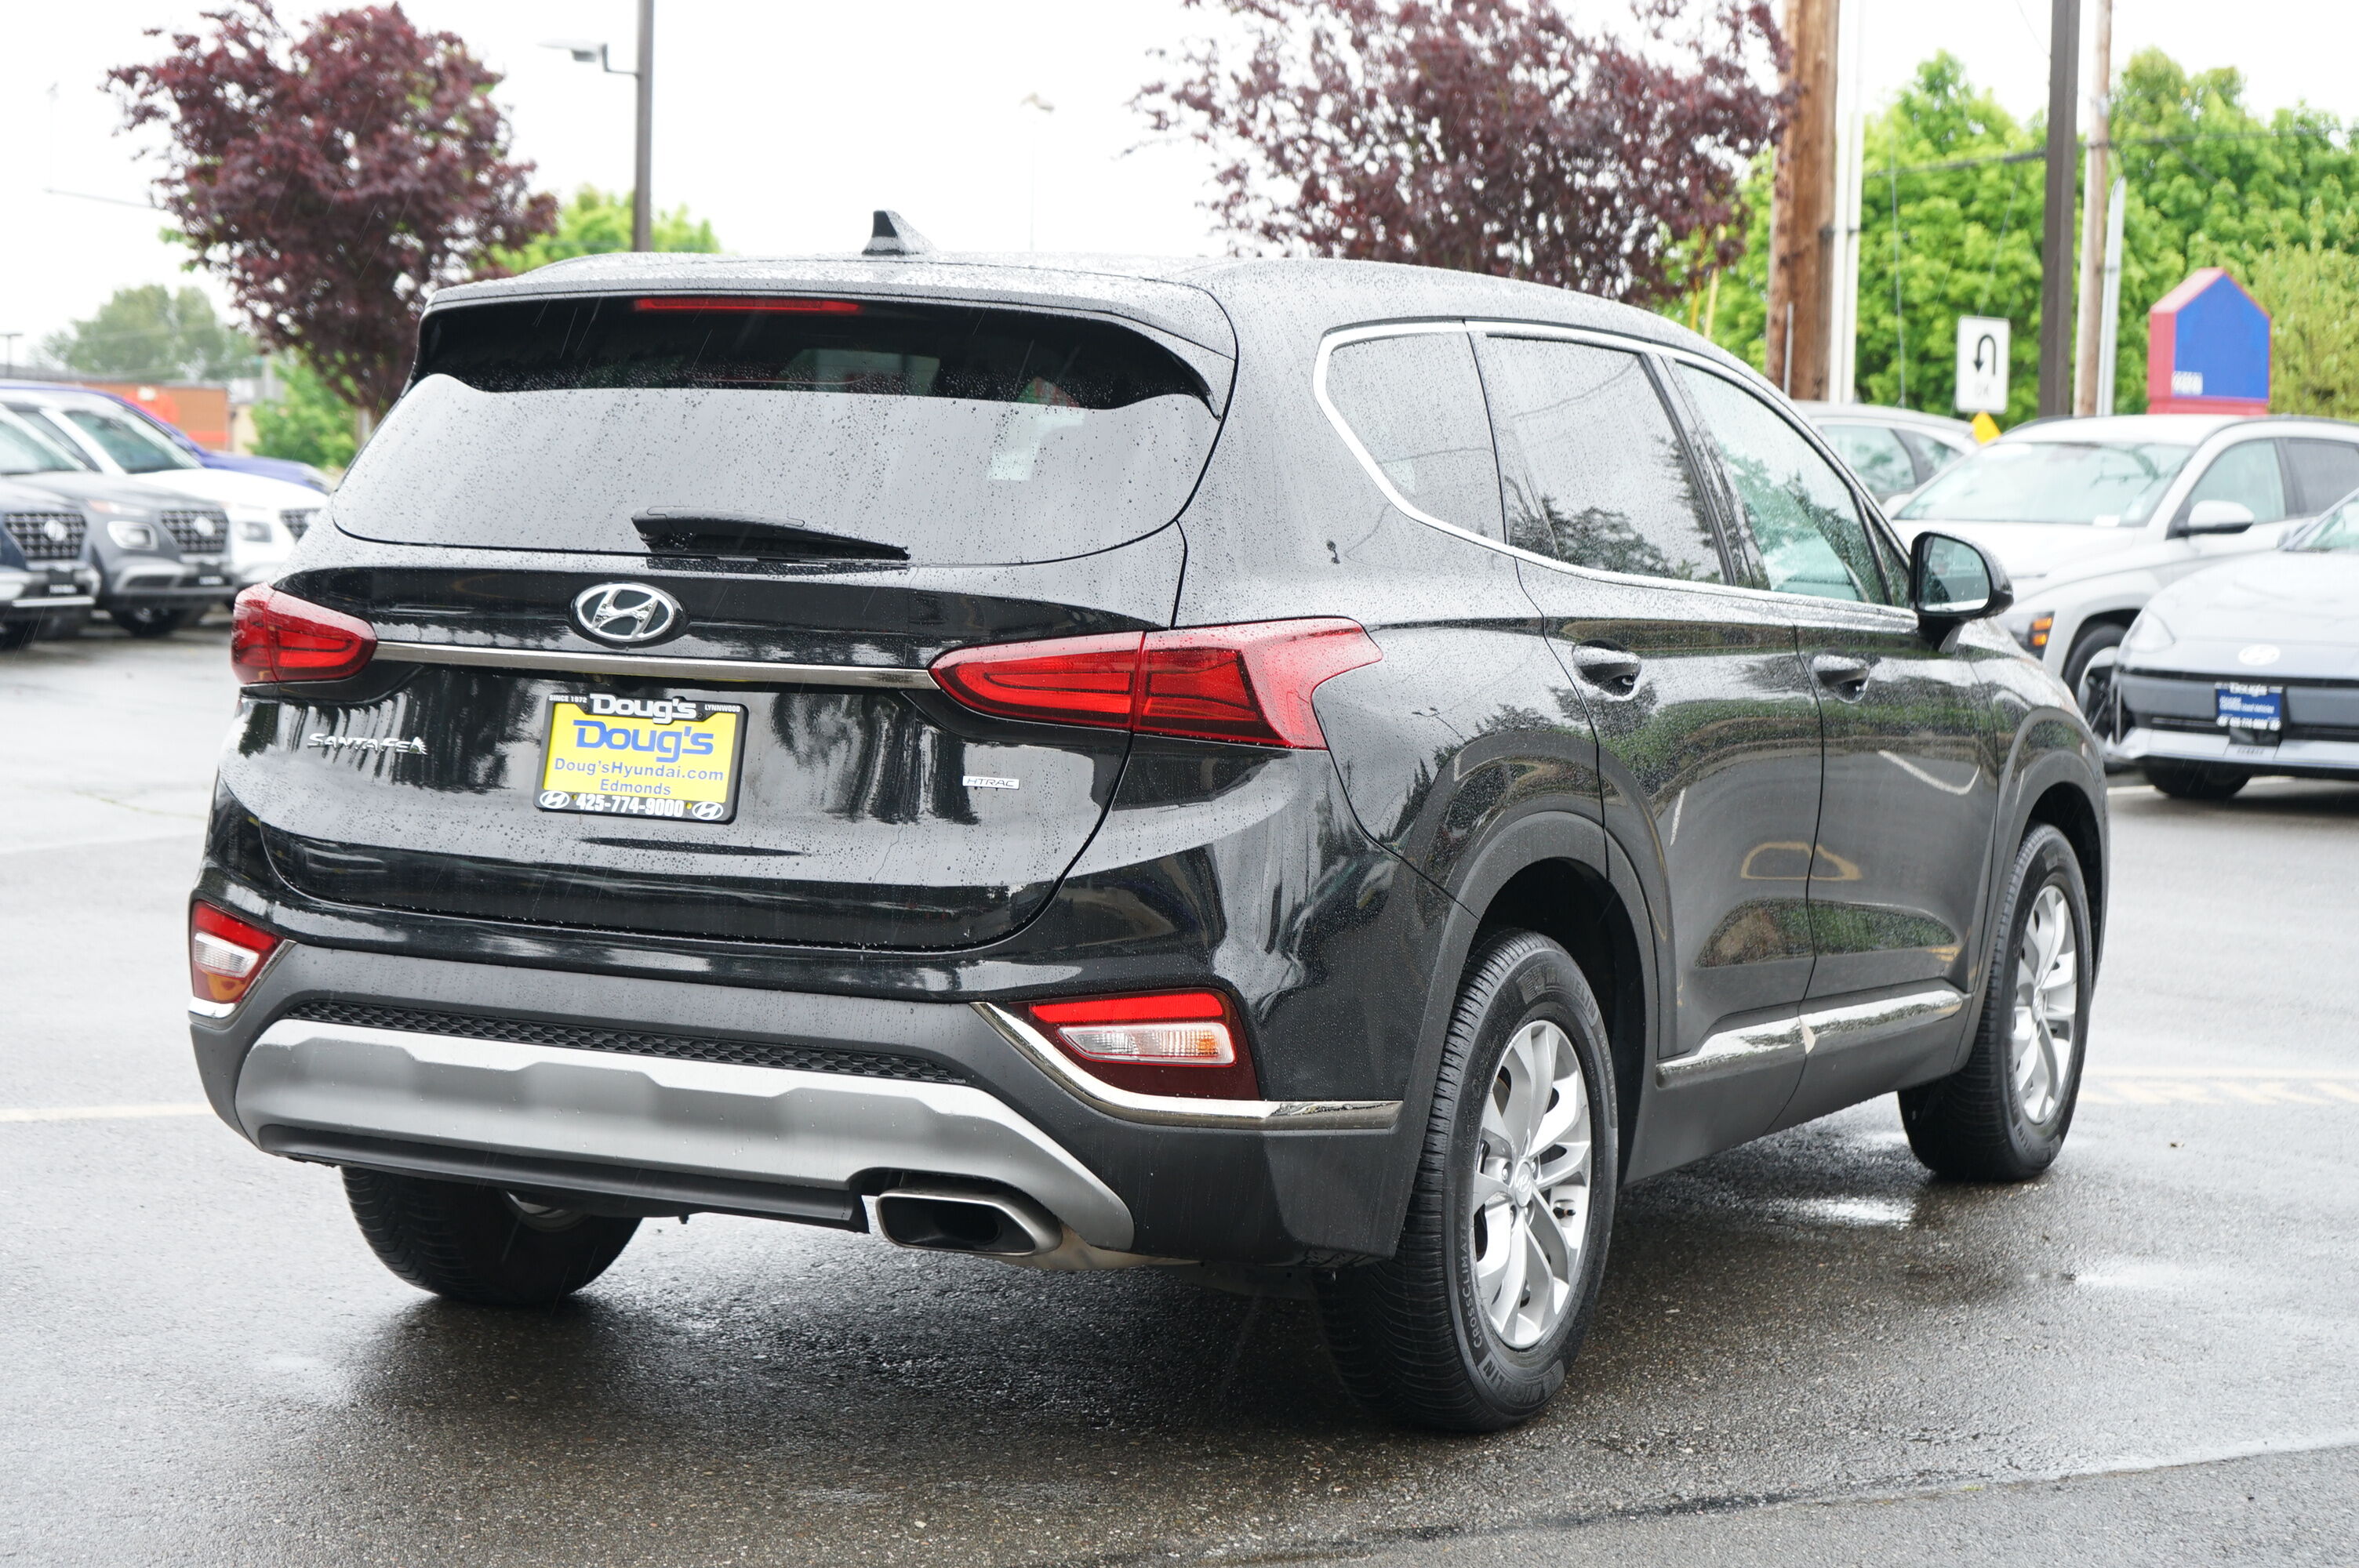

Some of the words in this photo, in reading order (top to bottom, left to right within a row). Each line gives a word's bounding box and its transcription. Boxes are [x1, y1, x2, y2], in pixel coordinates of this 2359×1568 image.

[590, 693, 696, 724] Doug's
[704, 703, 741, 712] LYNNWOOD
[572, 719, 714, 764] Doug's
[554, 757, 724, 782] Doug'sHyundai.com
[600, 779, 671, 796] Edmonds
[966, 778, 1016, 787] HTRAC
[575, 793, 684, 818] 425-774-9000
